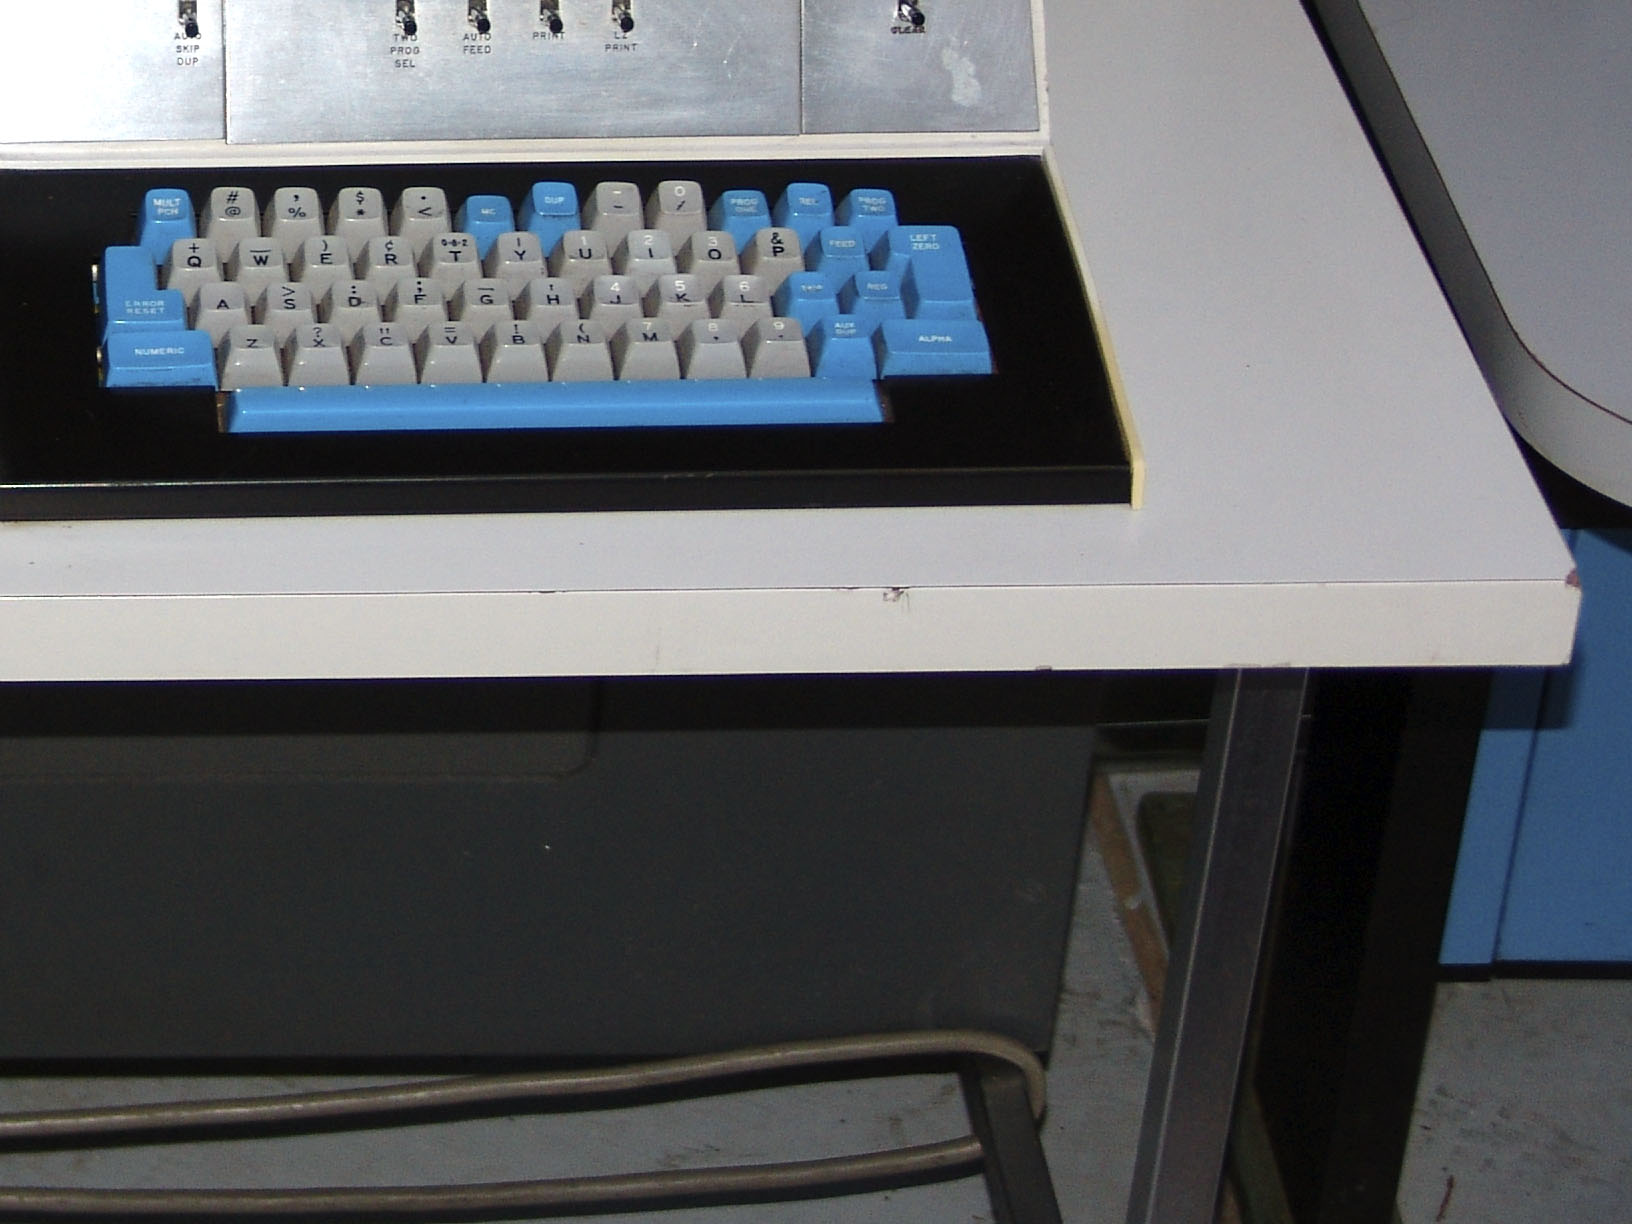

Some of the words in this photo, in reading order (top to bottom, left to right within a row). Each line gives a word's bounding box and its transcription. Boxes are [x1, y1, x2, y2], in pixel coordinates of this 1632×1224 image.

[393, 33, 418, 42] TWO
[532, 31, 565, 40] PRINT
[176, 45, 200, 54] SKIP
[390, 46, 420, 55] PROG
[463, 44, 492, 55] FEED
[605, 42, 639, 52] PRINT
[177, 57, 199, 66] DUP
[395, 58, 416, 69] SEL
[227, 191, 239, 203] #
[356, 191, 364, 205] $
[544, 196, 565, 204] DUP
[153, 198, 181, 207] MULT
[676, 200, 685, 210] /
[225, 207, 241, 216] @
[288, 207, 306, 218] %
[418, 207, 431, 216] <
[581, 236, 587, 245] 1
[643, 235, 654, 245] 2
[708, 237, 718, 246] 3
[771, 232, 784, 245] &
[189, 243, 200, 253] +
[322, 240, 328, 251] )
[449, 251, 461, 262] T
[514, 250, 526, 260] Y
[579, 248, 592, 259] U
[773, 246, 785, 257] P
[188, 255, 202, 267] Q
[253, 255, 268, 266] W
[320, 253, 333, 264] E
[385, 254, 398, 265] R
[610, 282, 621, 291] 4
[674, 280, 685, 291] 5
[739, 281, 750, 291] 6
[282, 286, 295, 296] >
[349, 297, 362, 307] D
[415, 295, 426, 304] F
[480, 295, 493, 305] G
[547, 294, 560, 305] H
[610, 295, 621, 304] J
[676, 293, 689, 302] K
[740, 294, 754, 303] L
[216, 299, 229, 309] A
[284, 299, 296, 310] S
[579, 324, 584, 333] (
[643, 322, 651, 330] 7
[708, 323, 718, 331] 8
[773, 322, 784, 330] 9
[313, 327, 322, 337] ?
[643, 333, 658, 341] M
[246, 339, 258, 348] Z
[313, 339, 325, 347] X
[380, 337, 392, 345] C
[446, 336, 457, 344] V
[512, 336, 525, 344] B
[134, 347, 185, 355] NUMERIC
